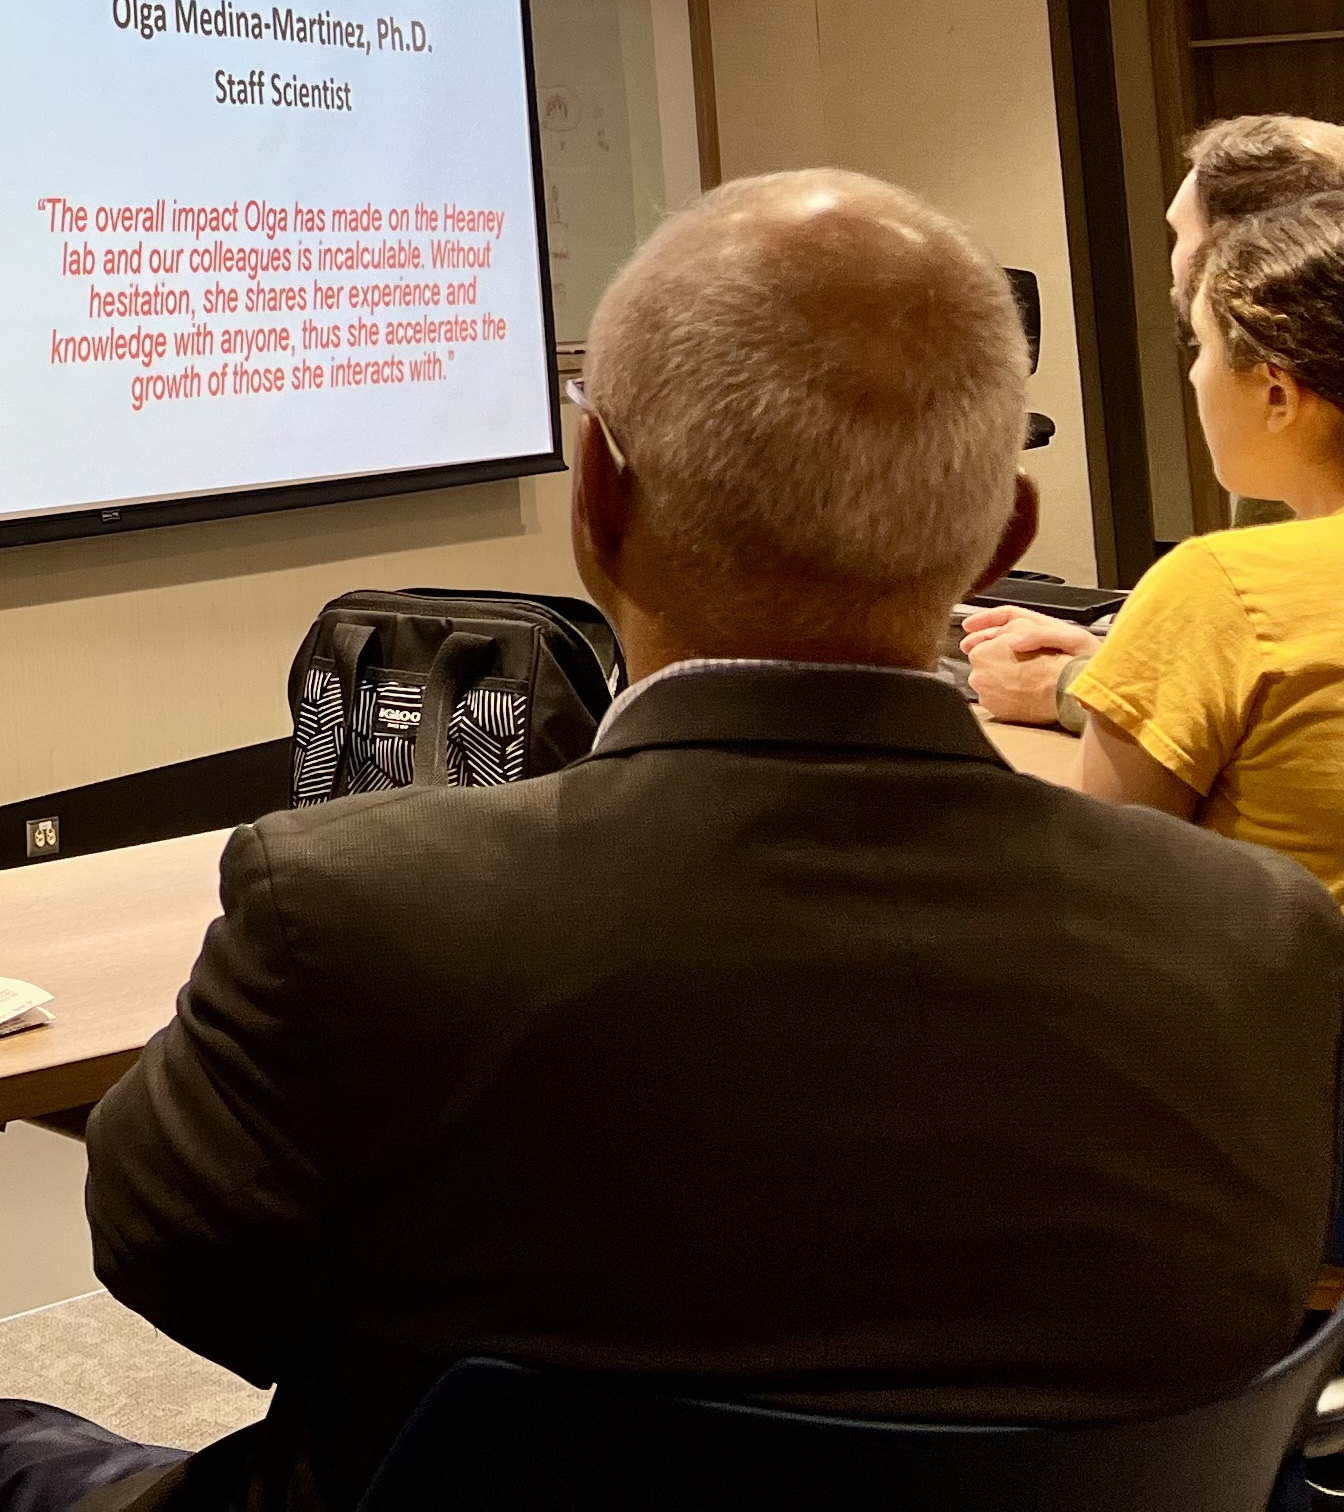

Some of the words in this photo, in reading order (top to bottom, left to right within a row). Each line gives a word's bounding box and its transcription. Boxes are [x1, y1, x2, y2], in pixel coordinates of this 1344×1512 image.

[175, 0, 370, 55] Medina-Martinez,
[377, 17, 432, 53] Ph.D.
[215, 70, 264, 105] Staff
[271, 73, 351, 111] Scientist
[96, 199, 165, 232] overall
[172, 200, 238, 240] impact
[245, 200, 287, 240] Olga
[294, 201, 325, 232] has
[332, 202, 382, 232] made
[389, 209, 409, 231] on
[415, 202, 438, 231] the
[444, 203, 504, 239] Heaney
[63, 242, 95, 276] lab
[103, 241, 142, 275] and
[149, 249, 184, 273] our
[190, 241, 291, 280] colleagues
[298, 241, 312, 271] is
[319, 239, 424, 271] incalculable.
[431, 240, 491, 269] Without
[89, 282, 195, 320] hesitation,
[203, 281, 238, 313] she
[245, 280, 307, 312] shares
[314, 279, 344, 310] her
[349, 277, 440, 315] experience
[446, 276, 476, 305] and
[51, 325, 166, 367] knowledge
[174, 323, 213, 357] with
[221, 328, 295, 362] anyone,
[302, 319, 341, 349] thus
[347, 317, 379, 347] she
[385, 314, 477, 344] accelerates
[482, 312, 506, 340] the
[132, 365, 201, 411] growth
[208, 363, 228, 396] of
[233, 362, 285, 394] those
[292, 358, 324, 390] she
[331, 355, 404, 387] interacts
